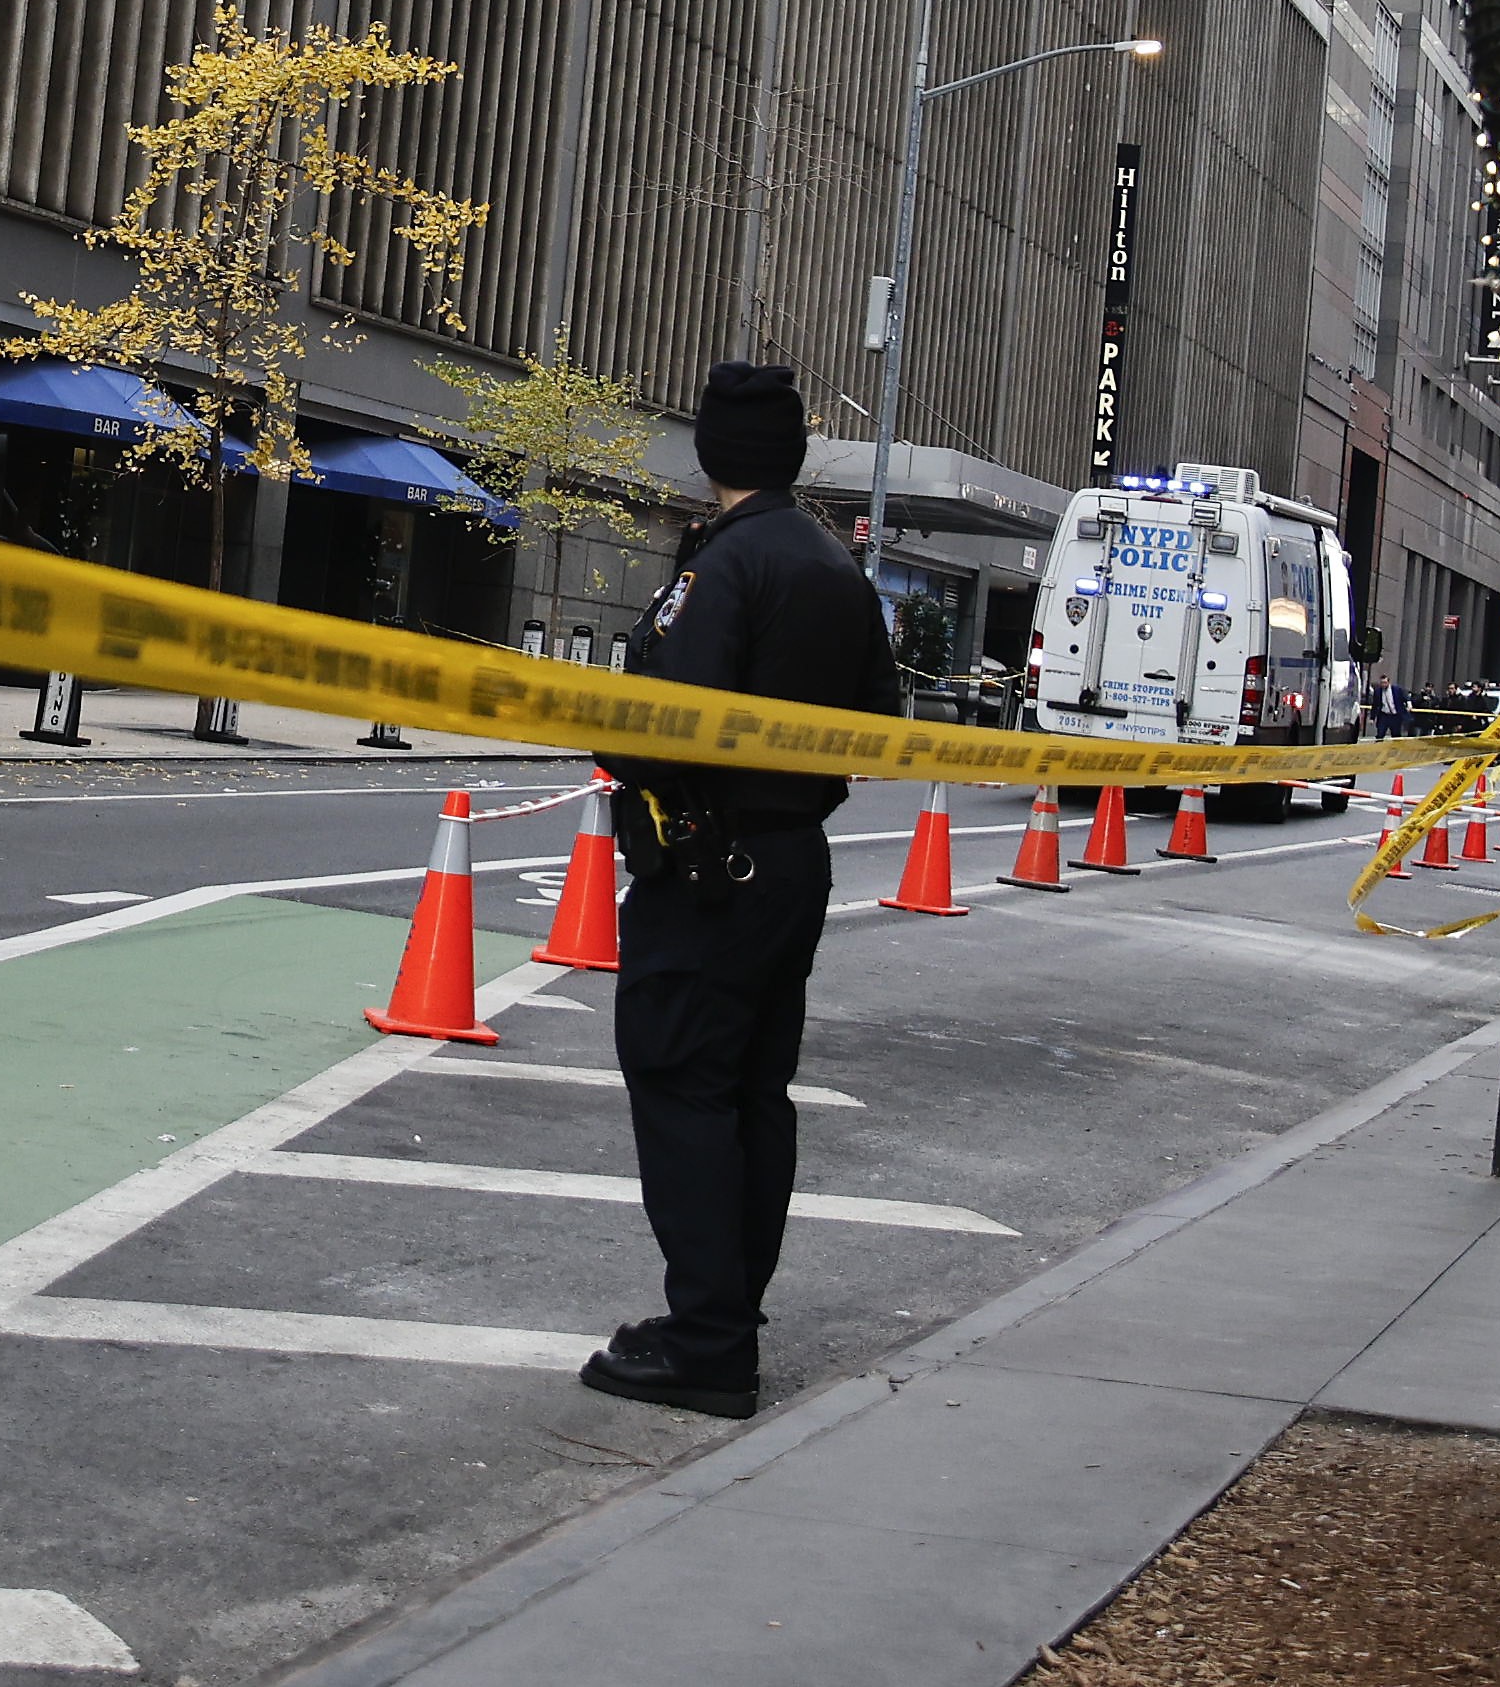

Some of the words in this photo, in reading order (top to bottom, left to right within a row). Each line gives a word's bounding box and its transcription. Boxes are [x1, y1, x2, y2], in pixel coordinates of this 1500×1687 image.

[1111, 167, 1136, 281] Hilton
[1096, 343, 1119, 442] PARK
[94, 418, 121, 436] BAR
[407, 487, 428, 502] BAR
[1119, 524, 1194, 550] NYPD
[1106, 582, 1148, 599] CRIME
[1131, 603, 1164, 619] UNIT
[1103, 680, 1129, 691] CRIME
[1132, 683, 1175, 697] STOPPERS
[51, 672, 67, 726] DING
[1104, 692, 1171, 708] 1-800-577-TIPS
